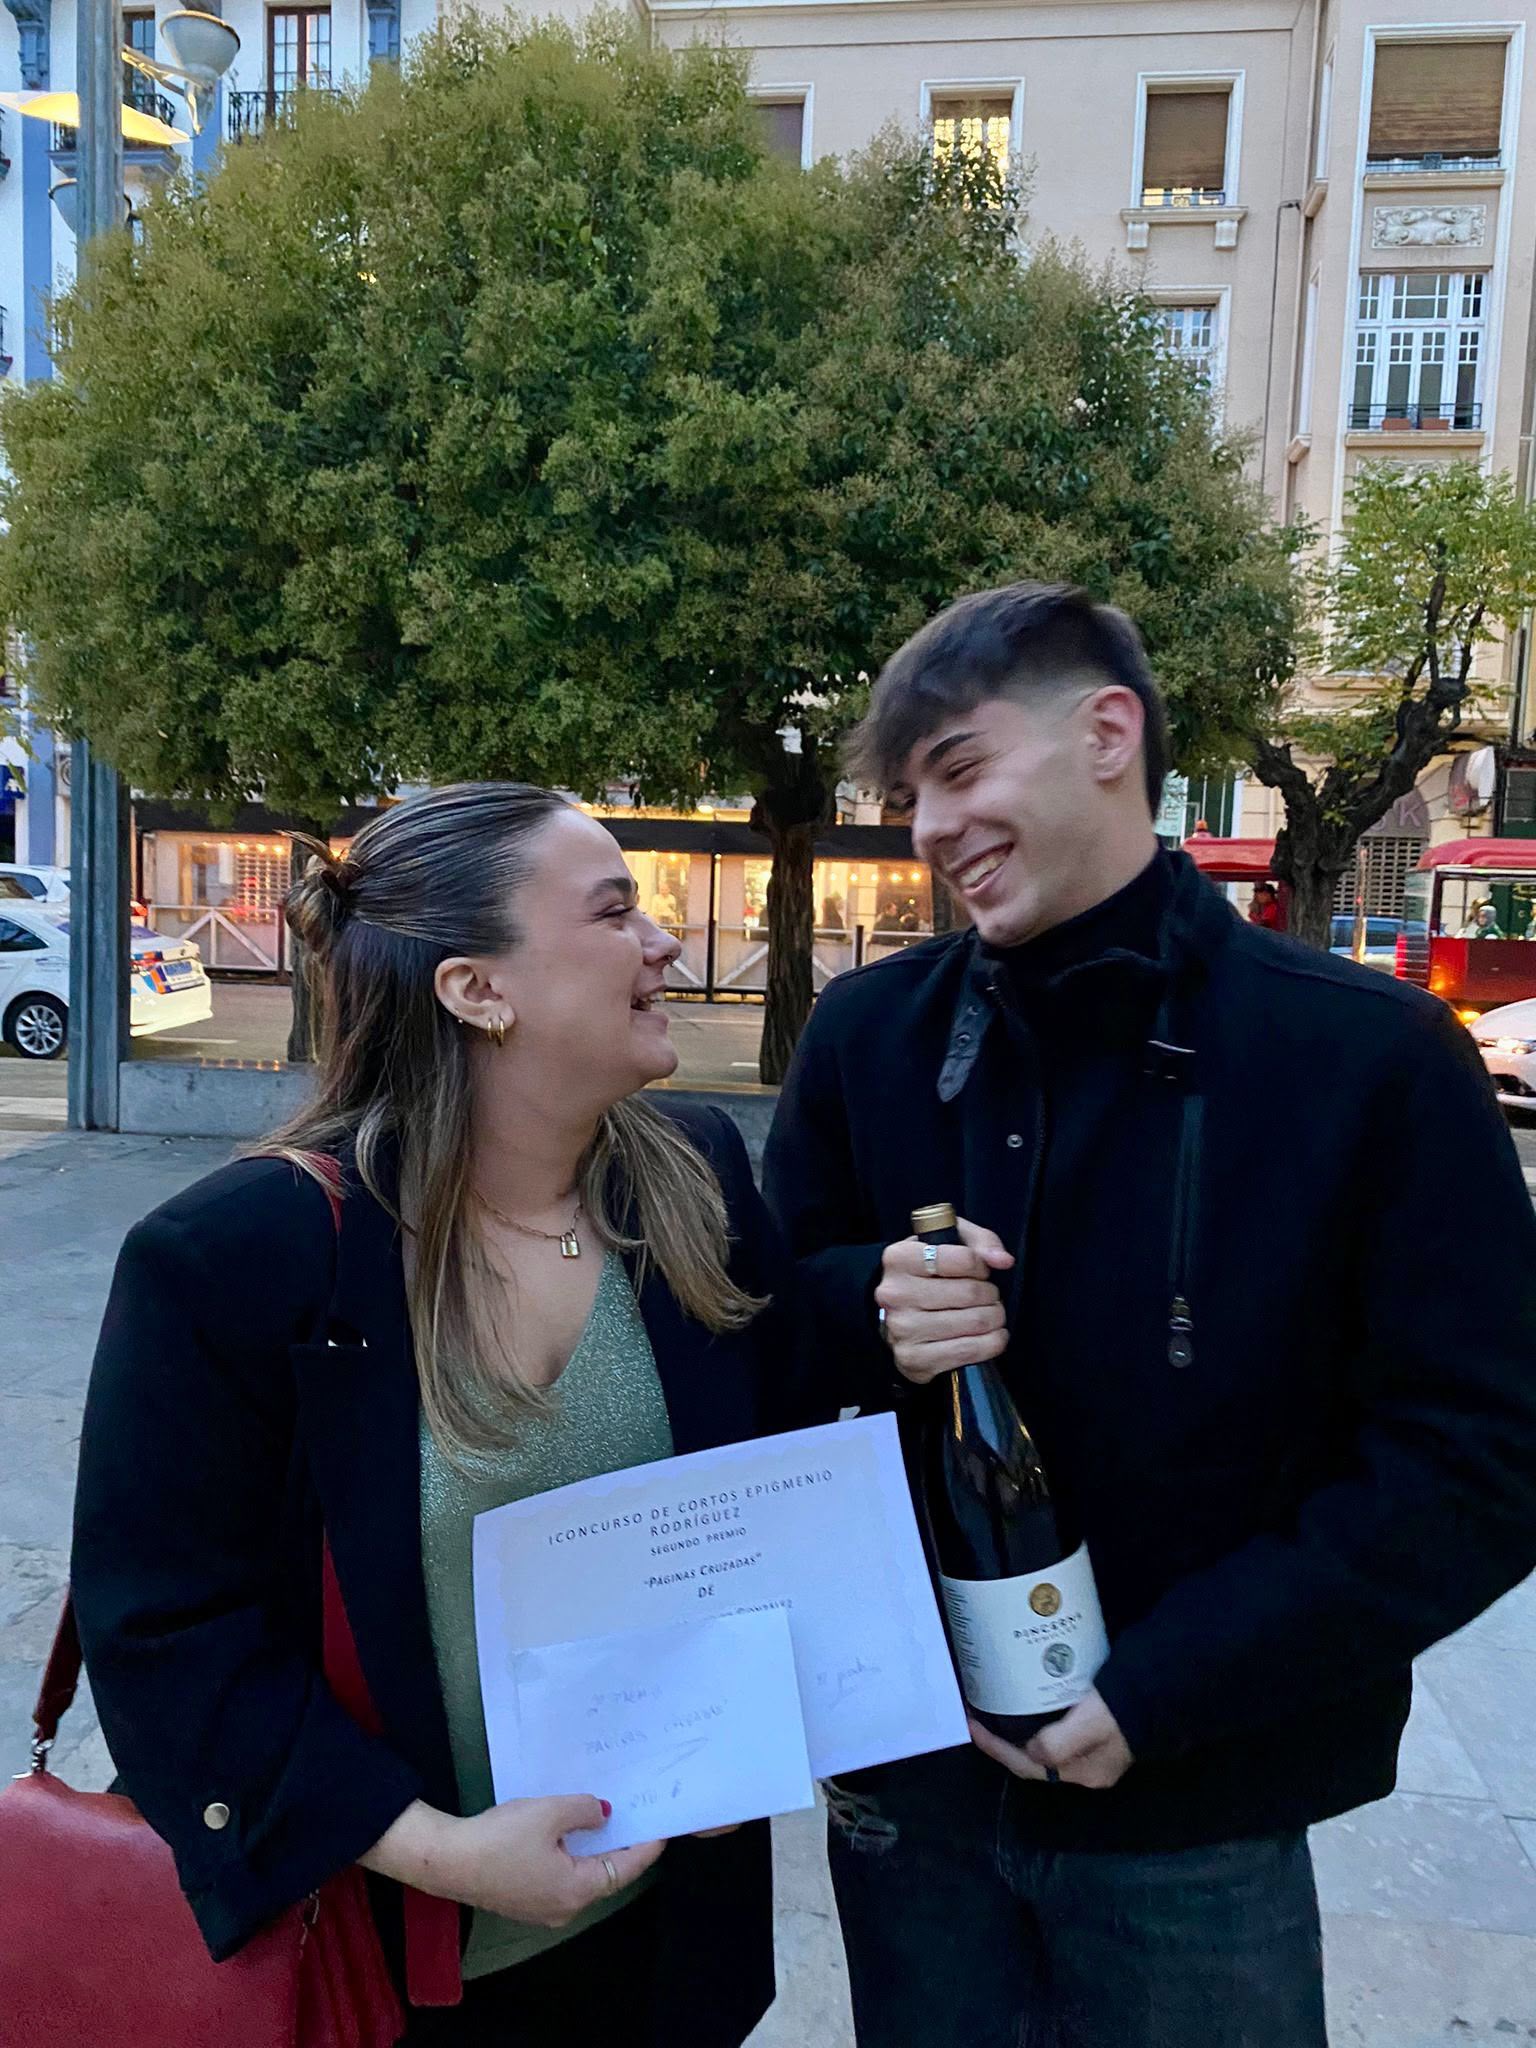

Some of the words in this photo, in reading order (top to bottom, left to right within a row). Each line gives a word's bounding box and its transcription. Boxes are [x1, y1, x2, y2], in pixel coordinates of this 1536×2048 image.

[651, 1506, 669, 1520] DE
[679, 1490, 738, 1513] CORTOS
[745, 1469, 833, 1498] EPIGMENIO
[650, 1506, 741, 1537] RODRÍGUEZ
[650, 1537, 700, 1557] SEGUNDO
[706, 1527, 747, 1543] PREMIO
[698, 1585, 716, 1598] DE
